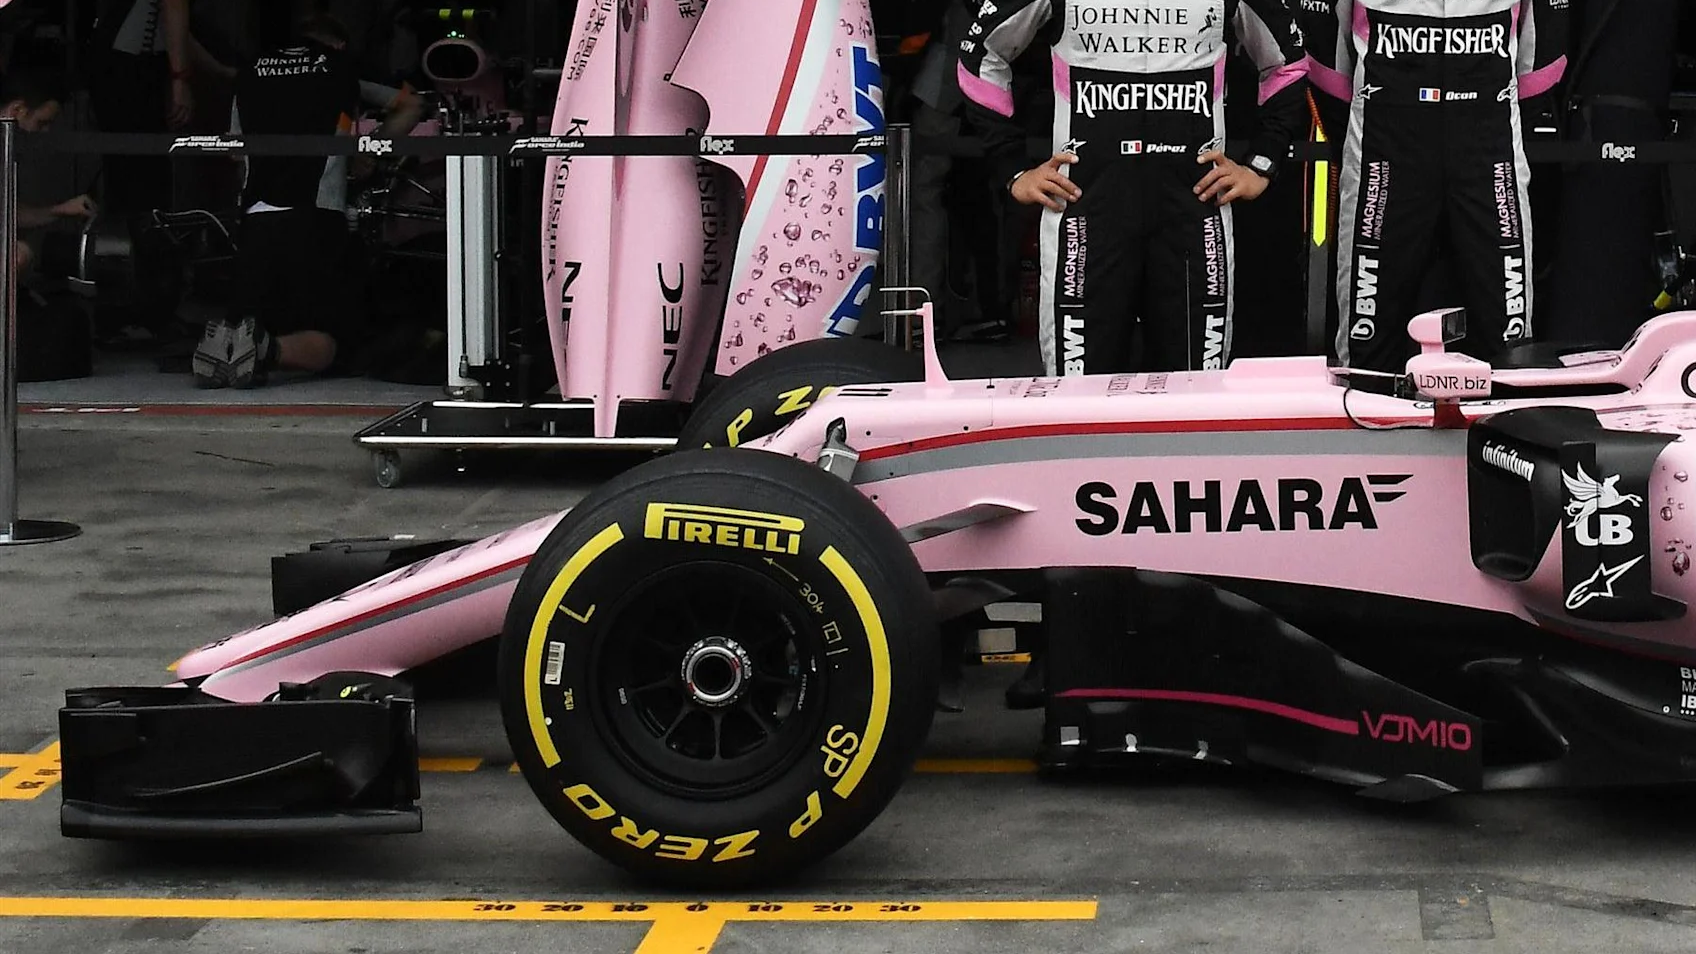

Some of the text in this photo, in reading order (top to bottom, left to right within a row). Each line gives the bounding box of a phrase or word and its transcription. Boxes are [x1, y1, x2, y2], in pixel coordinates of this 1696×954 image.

[1071, 5, 1189, 31] JOHNNIE
[1303, 0, 1330, 14] FXTM
[1078, 32, 1188, 54] WALKER
[1374, 23, 1509, 59] KINGFISHER
[257, 65, 309, 77] WALKER
[1075, 80, 1212, 118] KINGFISHER
[1445, 90, 1478, 101] Ocon
[357, 136, 392, 155] flex
[700, 136, 734, 154] flex
[1601, 143, 1636, 162] flex
[1361, 161, 1380, 238] MAGNESIUM
[1374, 161, 1390, 240] MINERALIZED WATER
[1493, 162, 1512, 238] MAGNESIUM
[1064, 217, 1079, 296] MAGNESIUM
[1076, 216, 1088, 298] MINERALIZED WATER
[1203, 216, 1219, 296] MAGNESIUM
[1355, 254, 1379, 316] BWT
[1503, 255, 1525, 316] BWT
[657, 262, 685, 391] NEC
[1063, 314, 1085, 377] BWT
[1202, 314, 1225, 371] BWT
[1417, 373, 1488, 392] LDNR.biz
[1482, 440, 1535, 482] infinitum
[644, 502, 805, 554] PIRELLI
[1074, 475, 1382, 536] SAHARA
[1362, 709, 1472, 750] VJM10
[562, 783, 825, 863] P ZERO
[473, 903, 922, 913] 30 20 10 0 10 20 30
